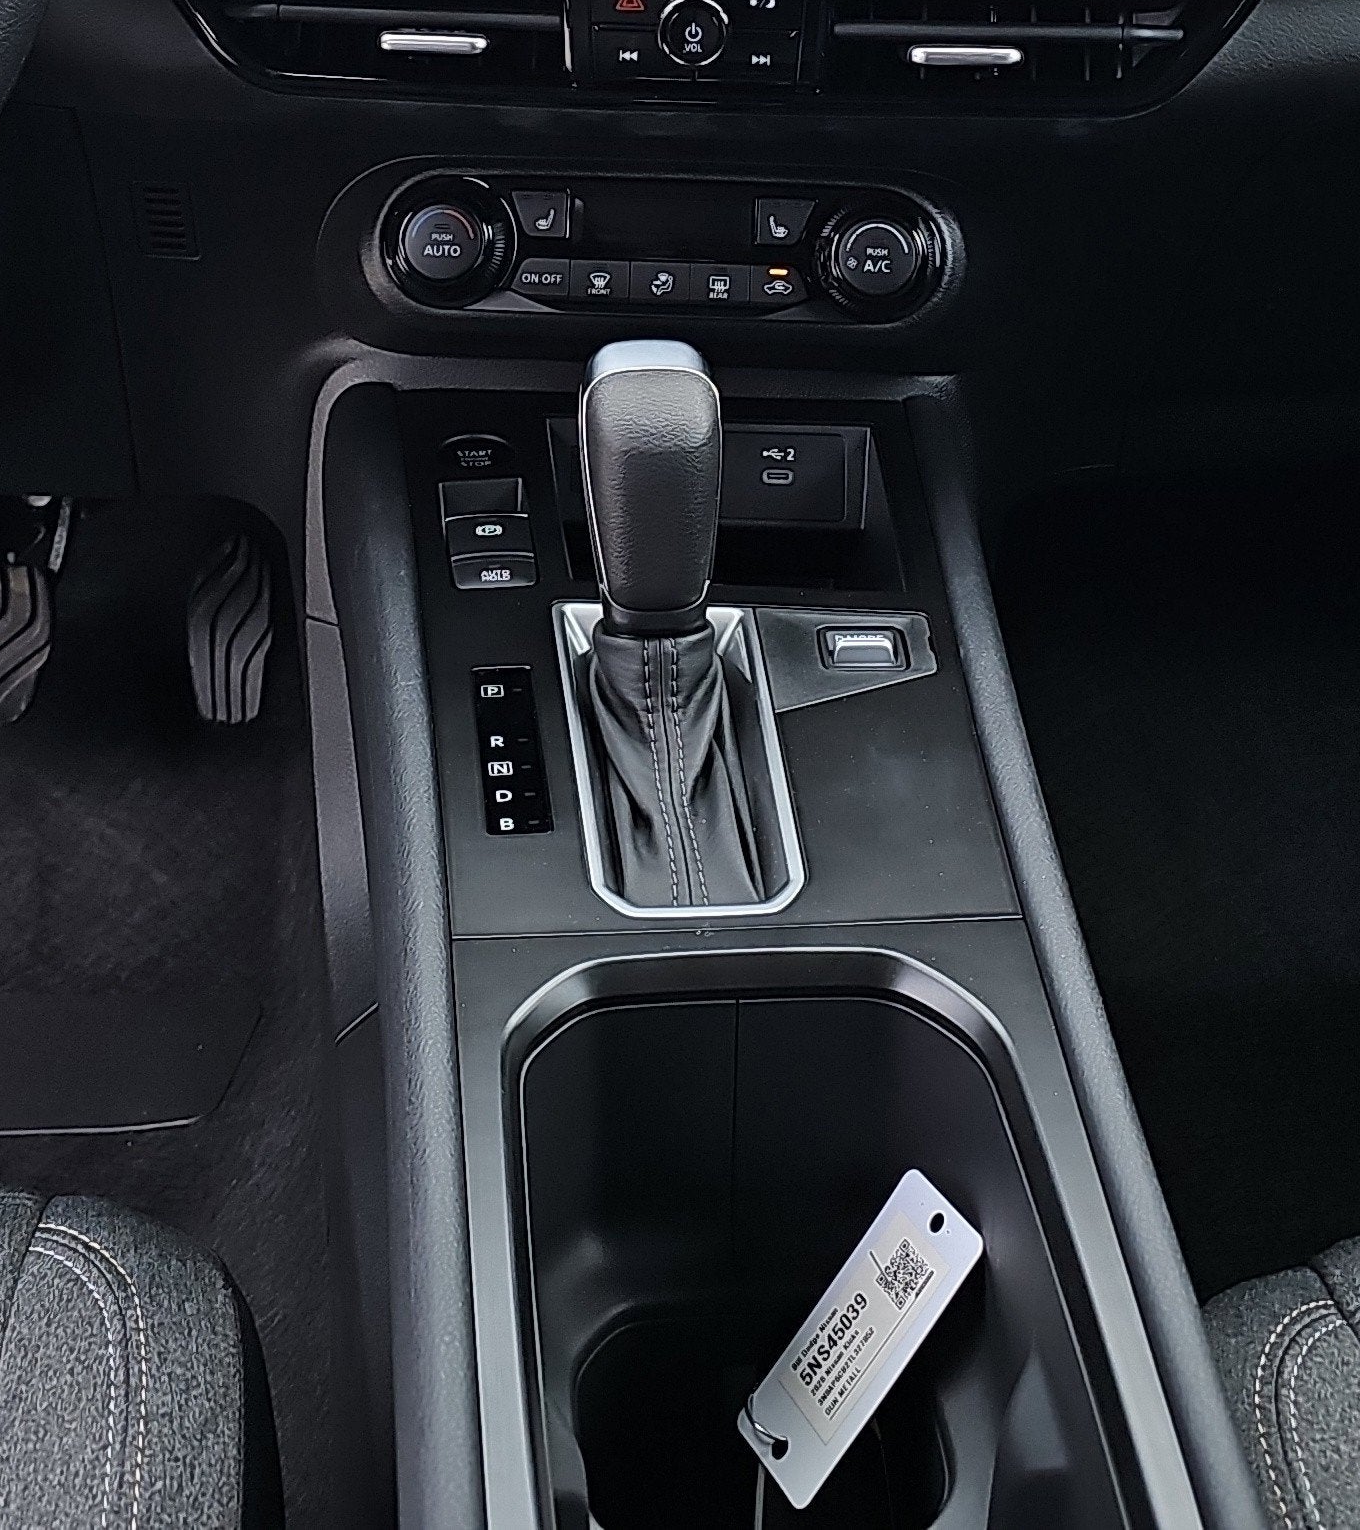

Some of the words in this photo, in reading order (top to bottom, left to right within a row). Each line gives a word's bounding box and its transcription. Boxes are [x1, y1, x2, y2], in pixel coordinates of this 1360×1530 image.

[684, 43, 703, 52] VOL
[431, 233, 453, 241] PUSH
[424, 245, 461, 257] AUTO
[867, 248, 888, 256] PUSH
[863, 259, 891, 273] A/C
[521, 273, 539, 283] ON
[542, 274, 563, 284] OFF
[457, 449, 493, 457] START
[786, 449, 795, 461] 2
[481, 569, 511, 577] AUTO
[490, 736, 505, 747] R
[495, 790, 513, 803] D
[500, 818, 514, 831] B
[799, 1293, 867, 1386] 5NS45039
